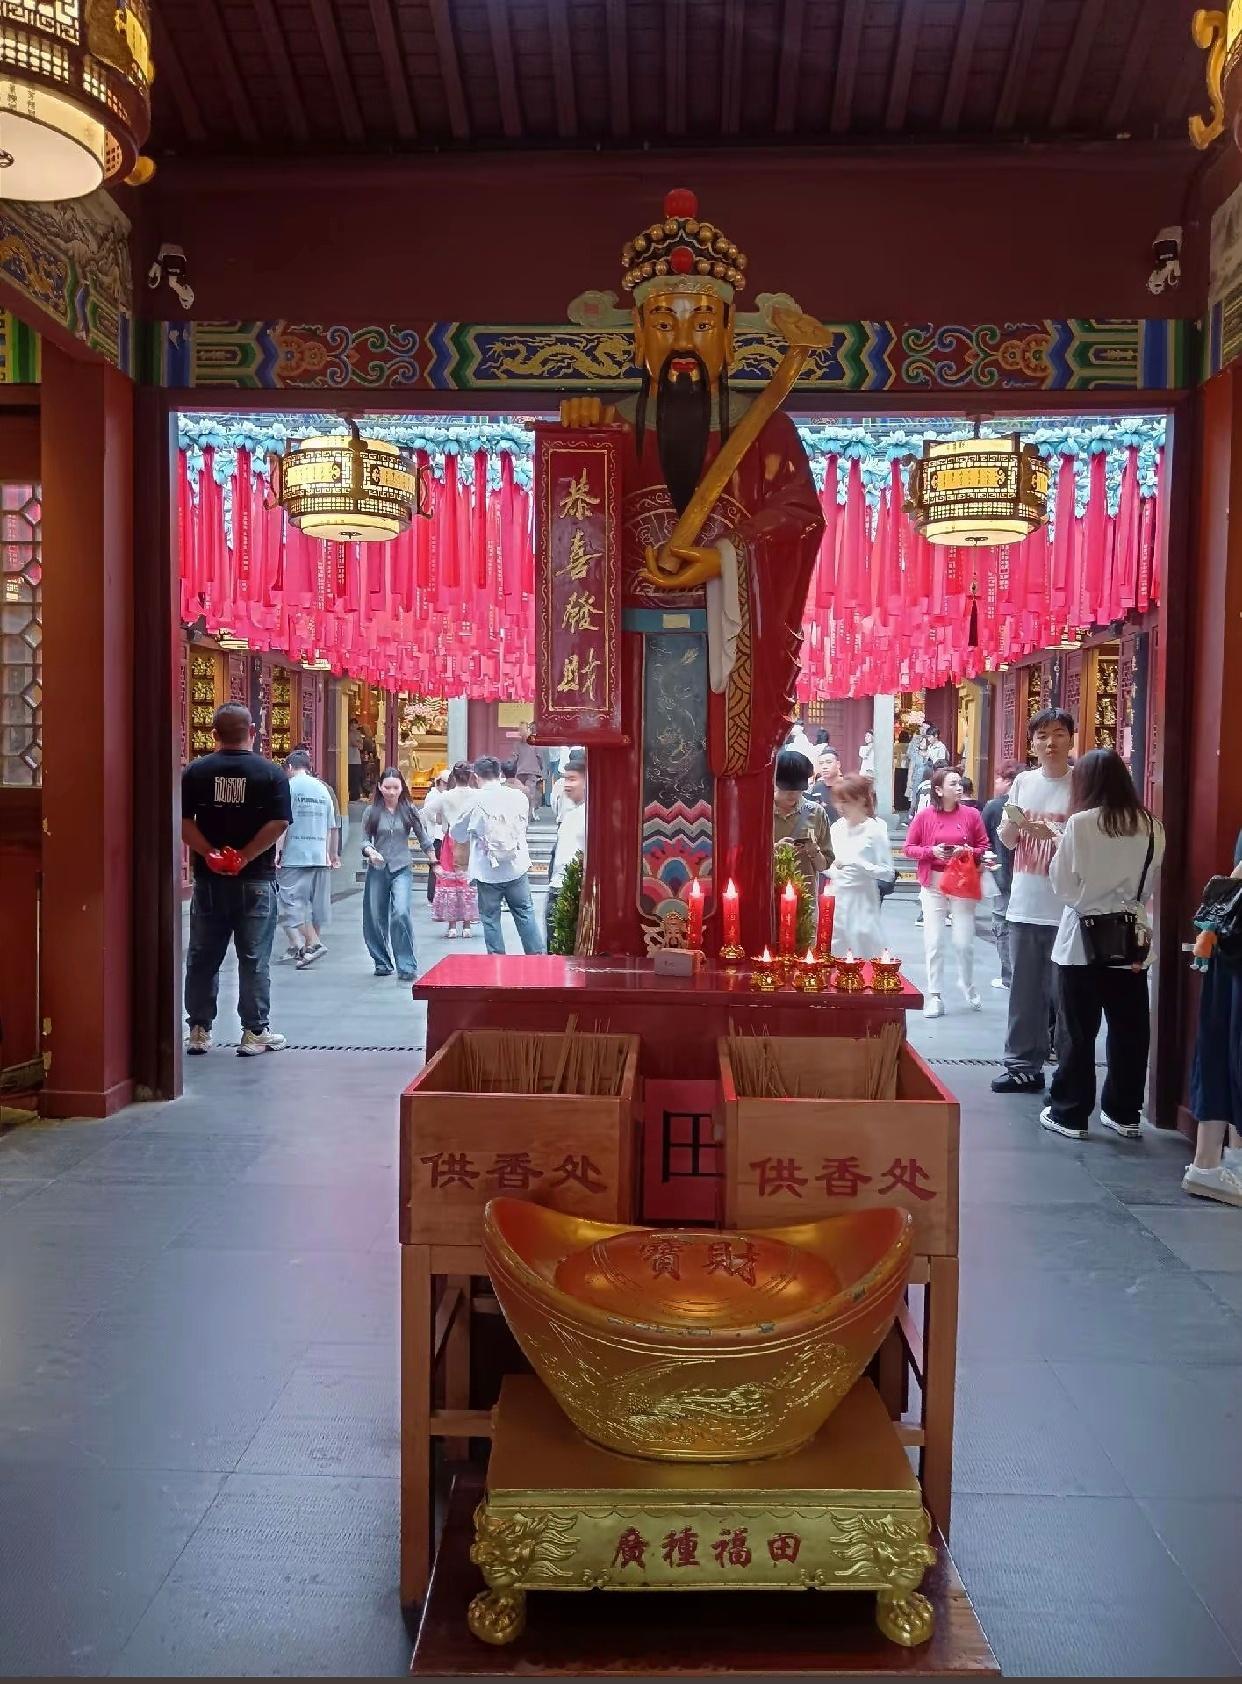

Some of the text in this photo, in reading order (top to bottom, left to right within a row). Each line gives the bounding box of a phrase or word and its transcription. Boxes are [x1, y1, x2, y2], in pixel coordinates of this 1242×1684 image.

[555, 467, 604, 702] 恭喜發財
[420, 1152, 608, 1194] 供香处
[749, 1156, 938, 1201] 供香处
[610, 1525, 802, 1569] 廣種福田
